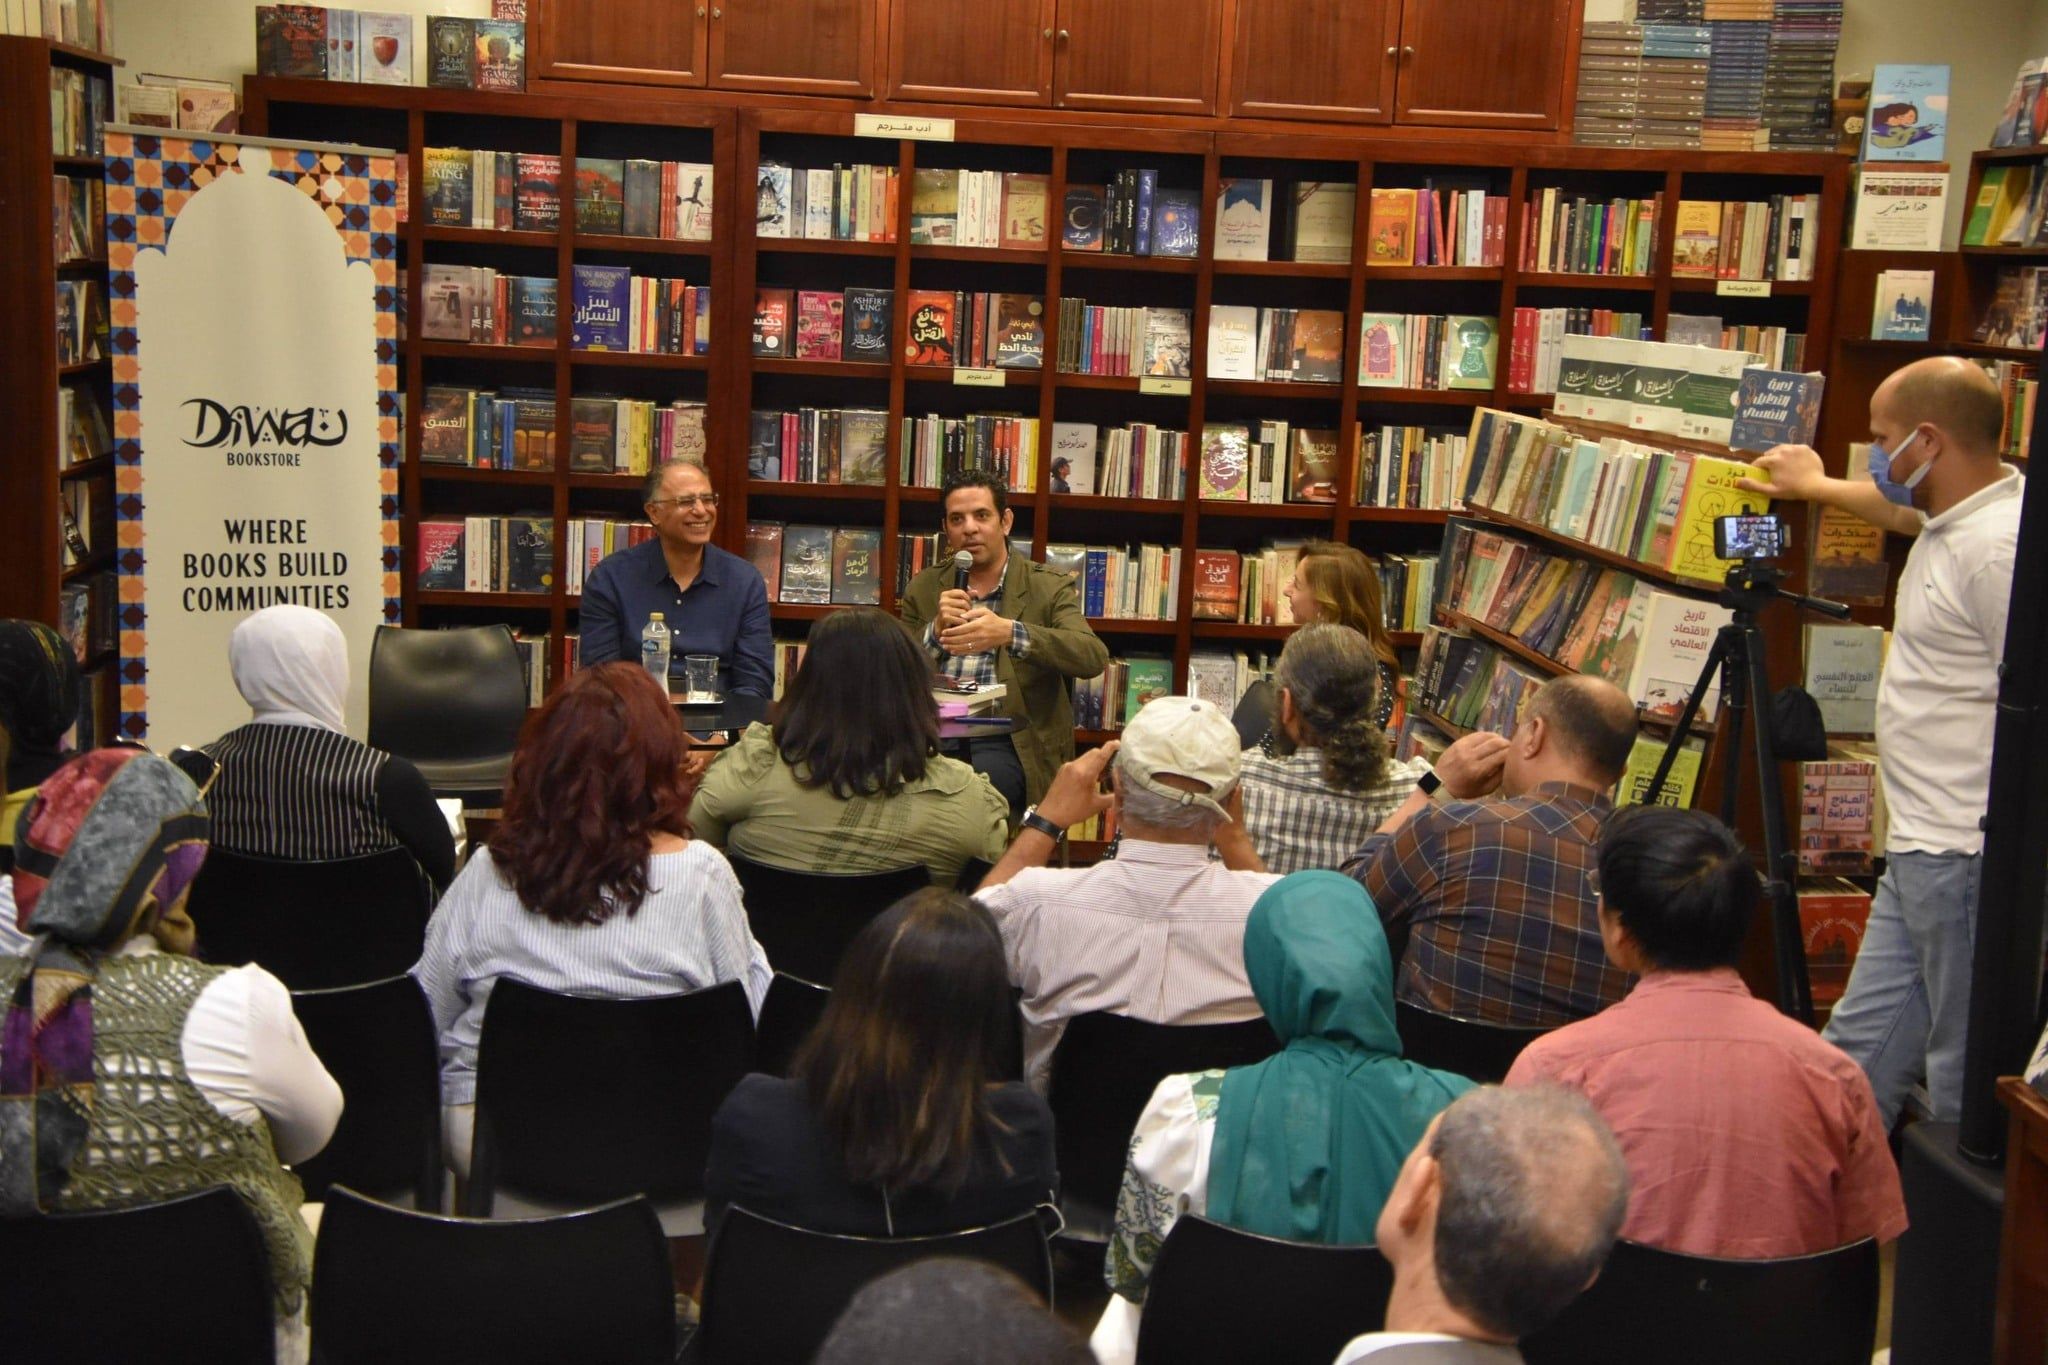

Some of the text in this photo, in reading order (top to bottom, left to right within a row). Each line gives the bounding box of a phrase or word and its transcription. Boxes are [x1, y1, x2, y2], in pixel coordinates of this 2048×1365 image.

[876, 122, 931, 132] أدب مترجم
[427, 161, 469, 170] STEPHEN
[431, 168, 464, 180] KING
[594, 271, 625, 280] BROWN
[853, 297, 888, 306] ASHFIRE
[859, 304, 881, 312] KING
[227, 452, 300, 467] BOOKSTORE
[224, 519, 307, 544] WHERE
[183, 551, 348, 578] BOOKS BUILD
[182, 584, 349, 612] COMMUNITIES
[1683, 609, 1706, 622] تاريخ
[1673, 624, 1709, 637] الاقتصاد
[1670, 638, 1708, 650] العالمي
